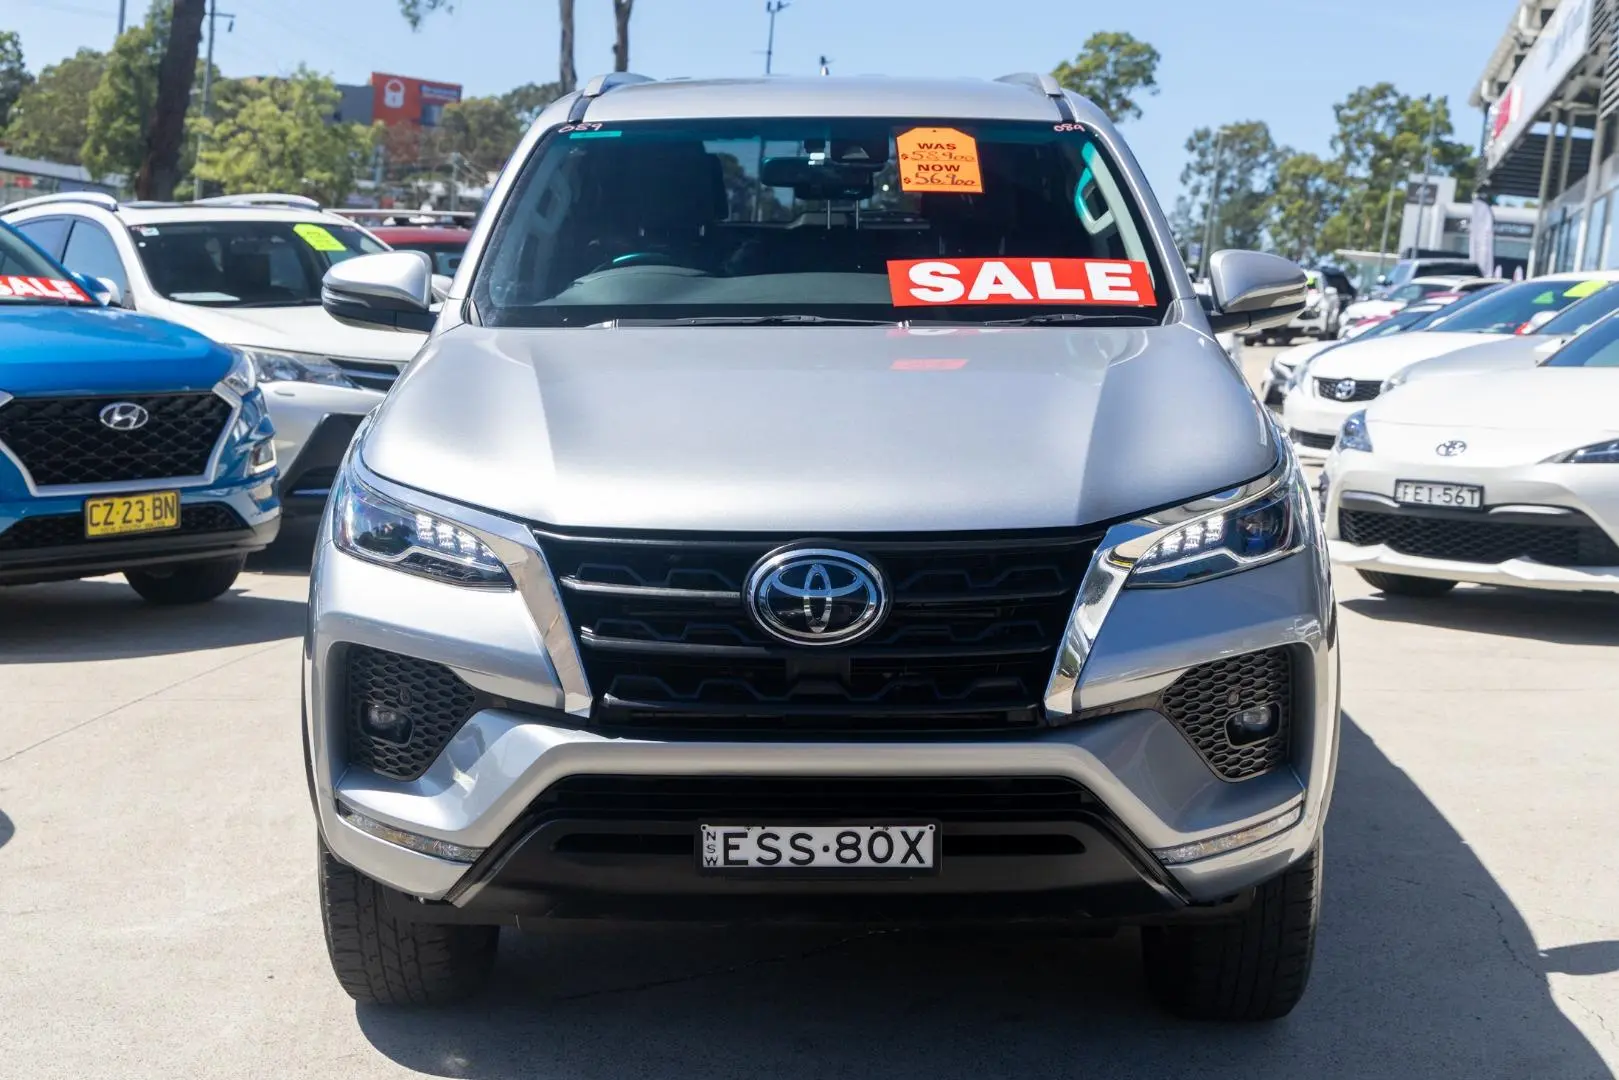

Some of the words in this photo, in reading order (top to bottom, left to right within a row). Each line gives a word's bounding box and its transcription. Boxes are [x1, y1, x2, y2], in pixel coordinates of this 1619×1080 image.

[917, 142, 957, 150] WAS
[917, 164, 960, 172] NOW
[908, 261, 1140, 302] SALE
